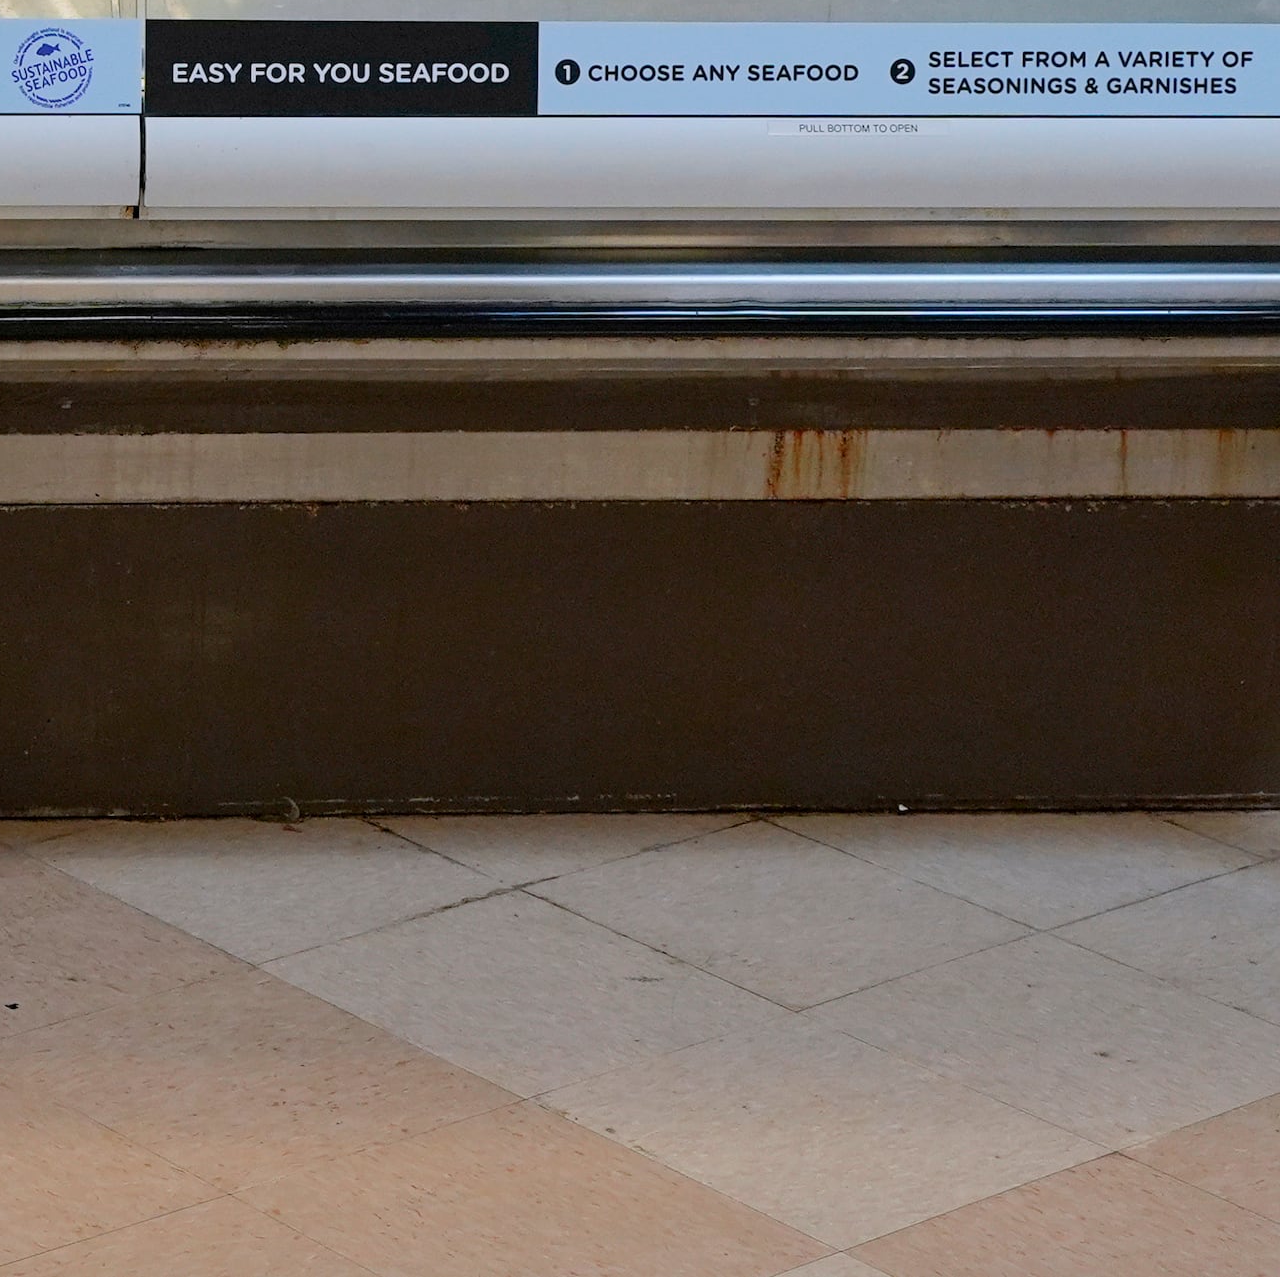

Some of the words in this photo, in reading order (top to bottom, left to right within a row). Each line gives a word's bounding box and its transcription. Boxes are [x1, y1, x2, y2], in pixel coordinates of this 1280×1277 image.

[11, 48, 94, 83] SUSTAINABLE
[929, 51, 1014, 68] SELECT
[1022, 51, 1087, 68] FROM
[1094, 51, 1110, 68] A
[1118, 51, 1215, 68] VARIETY
[1222, 51, 1253, 68] OF
[25, 65, 87, 92] SEAFOOD
[172, 62, 242, 83] EASY
[251, 62, 305, 83] FOR
[314, 62, 371, 83] YOU
[379, 62, 510, 83] SEAFOOD
[588, 64, 684, 81] CHOOSE
[692, 64, 740, 81] ANY
[748, 64, 859, 81] SEAFOOD
[928, 77, 1077, 94] SEASONINGS
[1084, 77, 1099, 94] &
[1107, 77, 1237, 94] GARNISHES
[799, 124, 824, 133] PULL
[827, 124, 870, 133] BOTTOM
[873, 124, 887, 133] TO
[890, 124, 918, 133] OPEN
